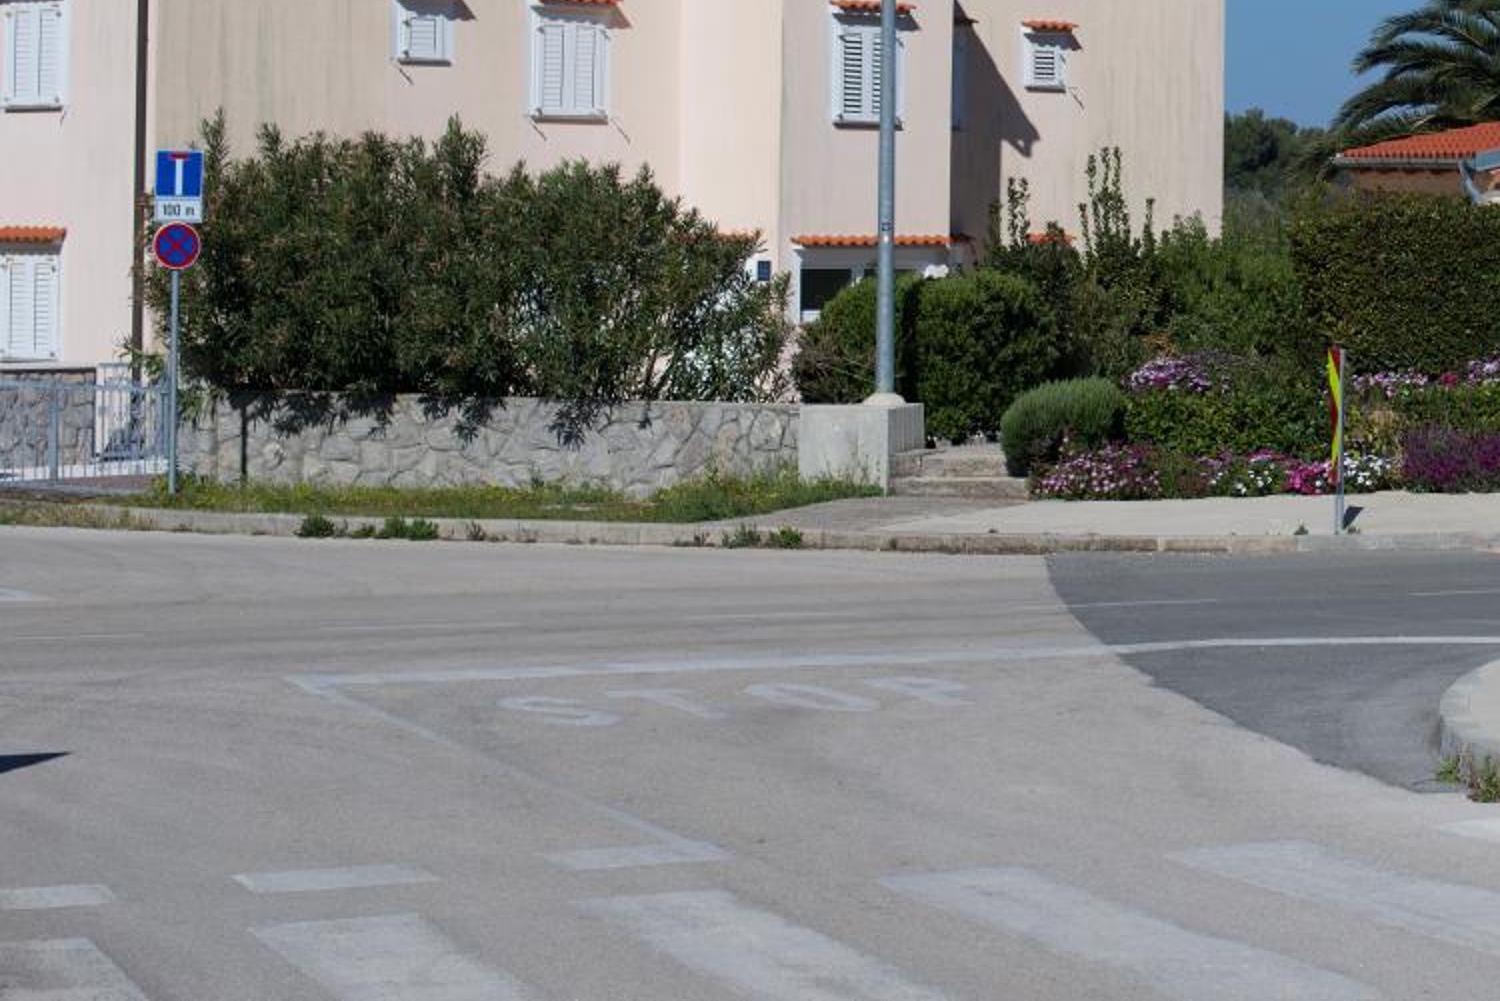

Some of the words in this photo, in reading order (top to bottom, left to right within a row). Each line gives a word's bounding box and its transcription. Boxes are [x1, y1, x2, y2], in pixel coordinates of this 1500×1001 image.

[163, 203, 181, 216] 100
[185, 206, 195, 216] m
[499, 676, 974, 727] STOP
